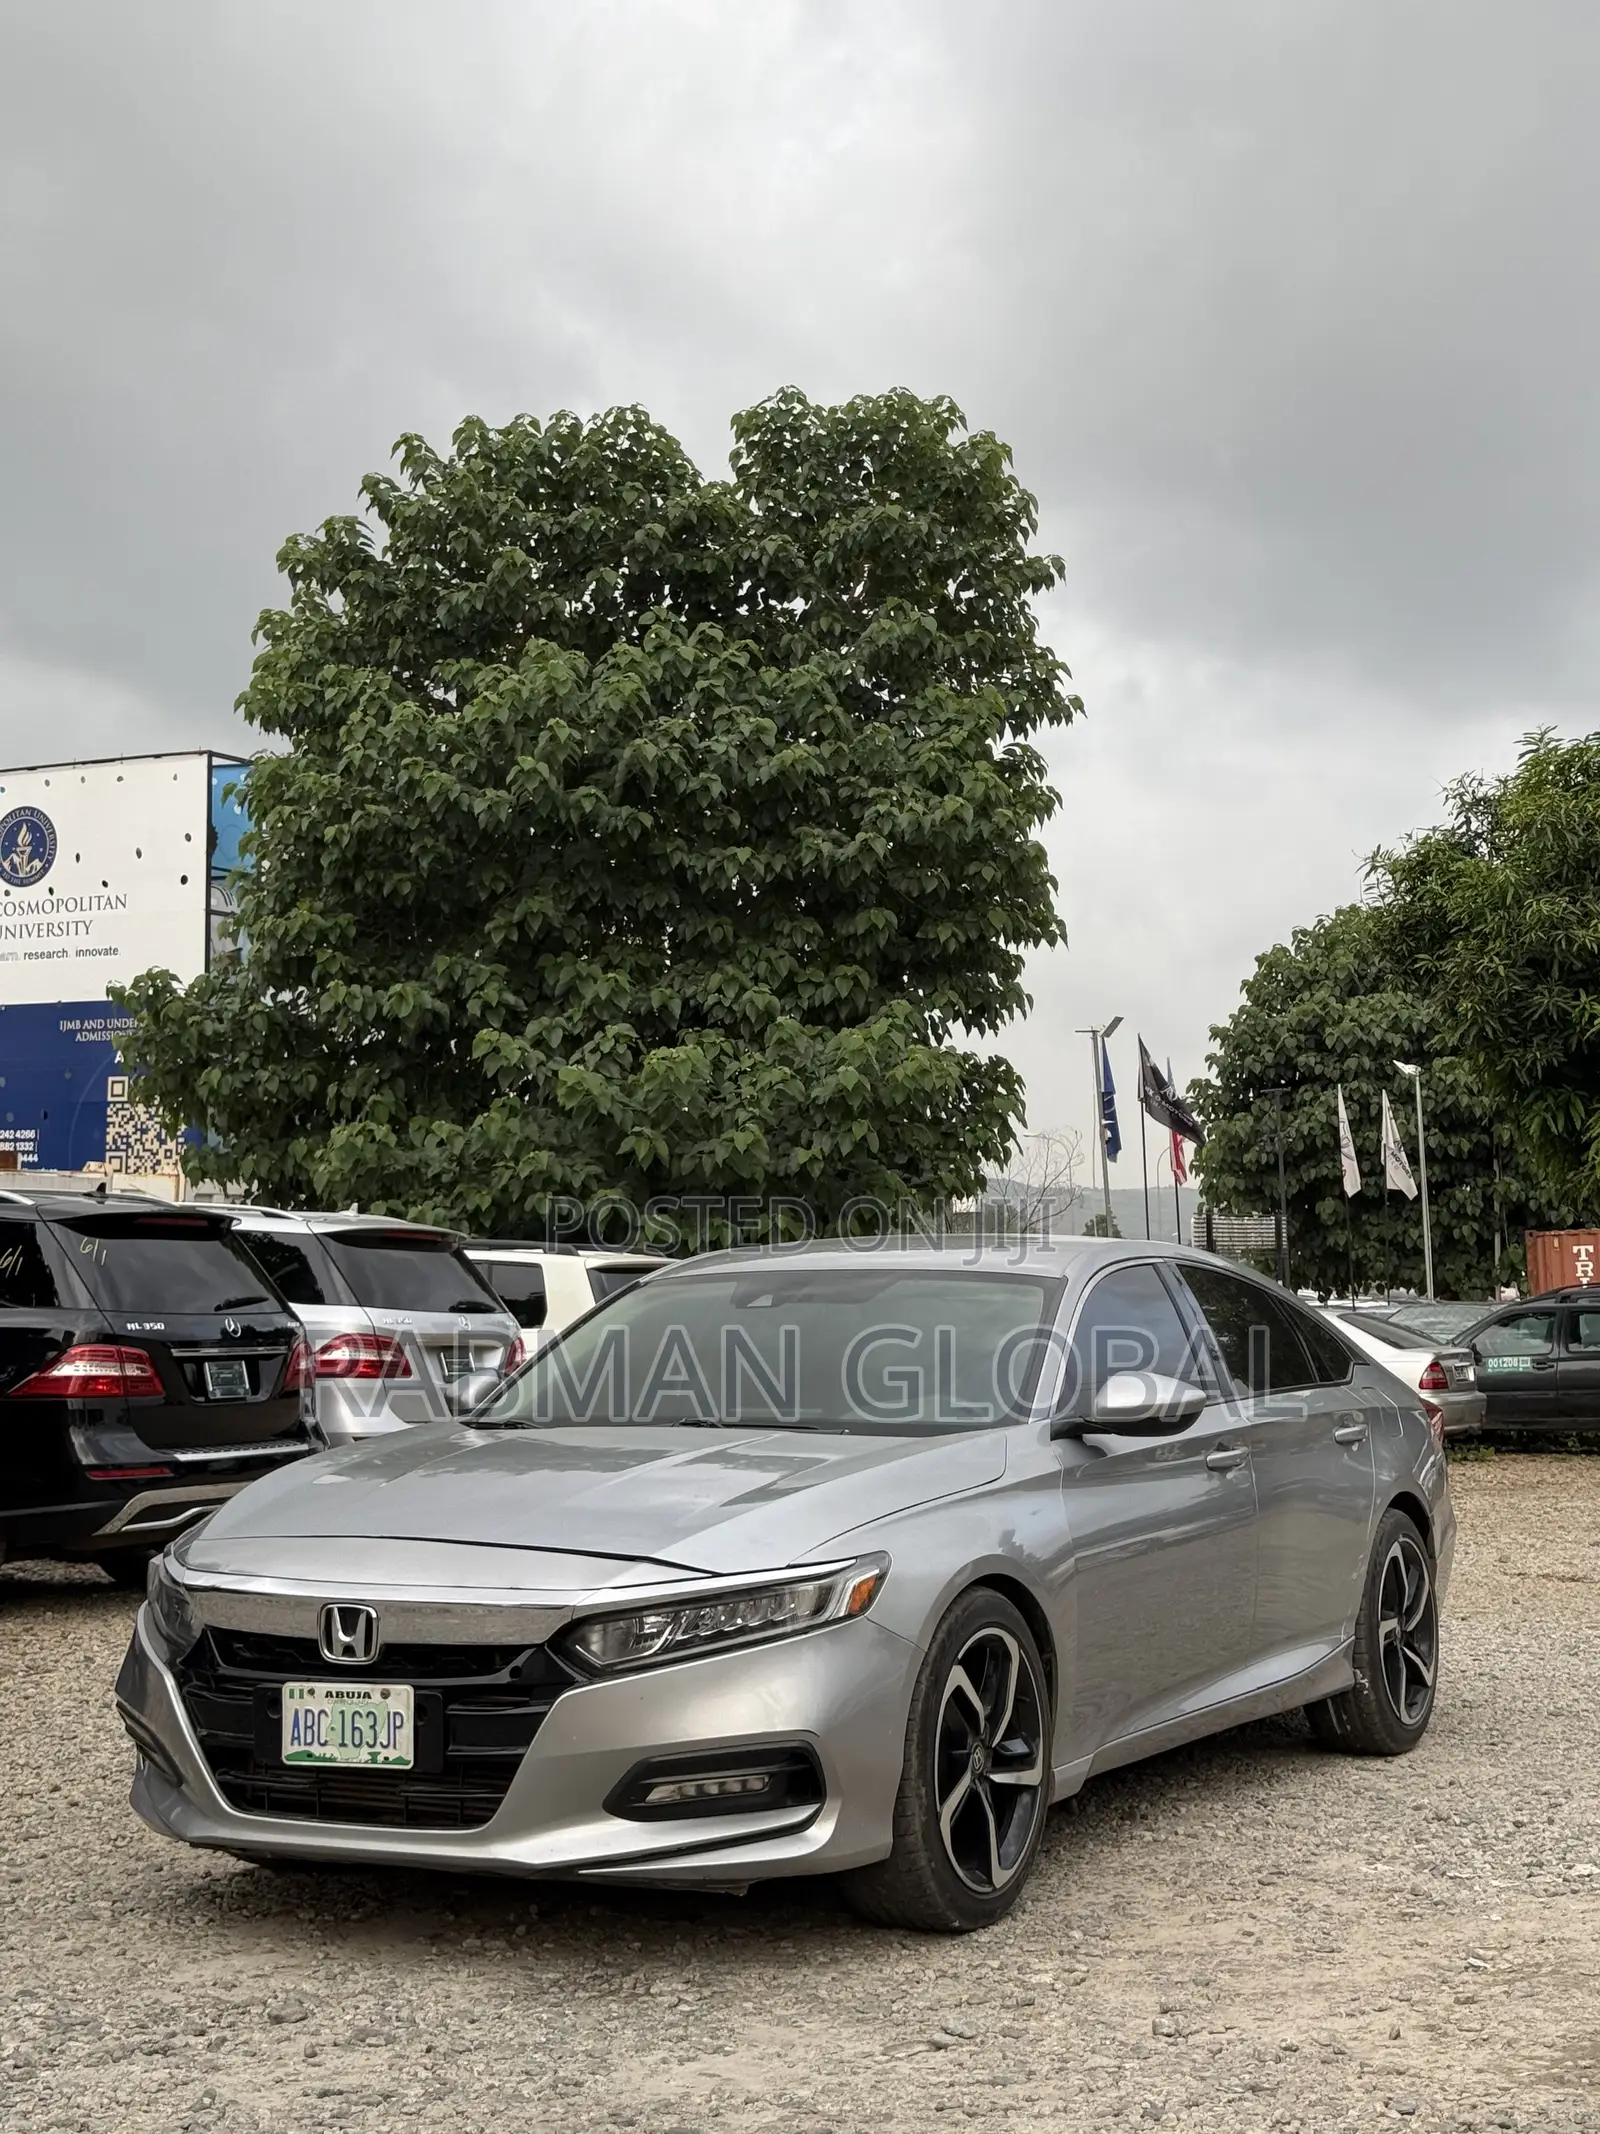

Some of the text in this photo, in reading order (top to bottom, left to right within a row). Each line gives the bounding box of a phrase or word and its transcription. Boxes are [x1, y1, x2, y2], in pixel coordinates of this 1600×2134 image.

[0, 894, 127, 917] OSMOPOLITAN
[82, 1019, 105, 1030] AND
[324, 1690, 372, 1700] ABUJA
[290, 1708, 329, 1747] ABC
